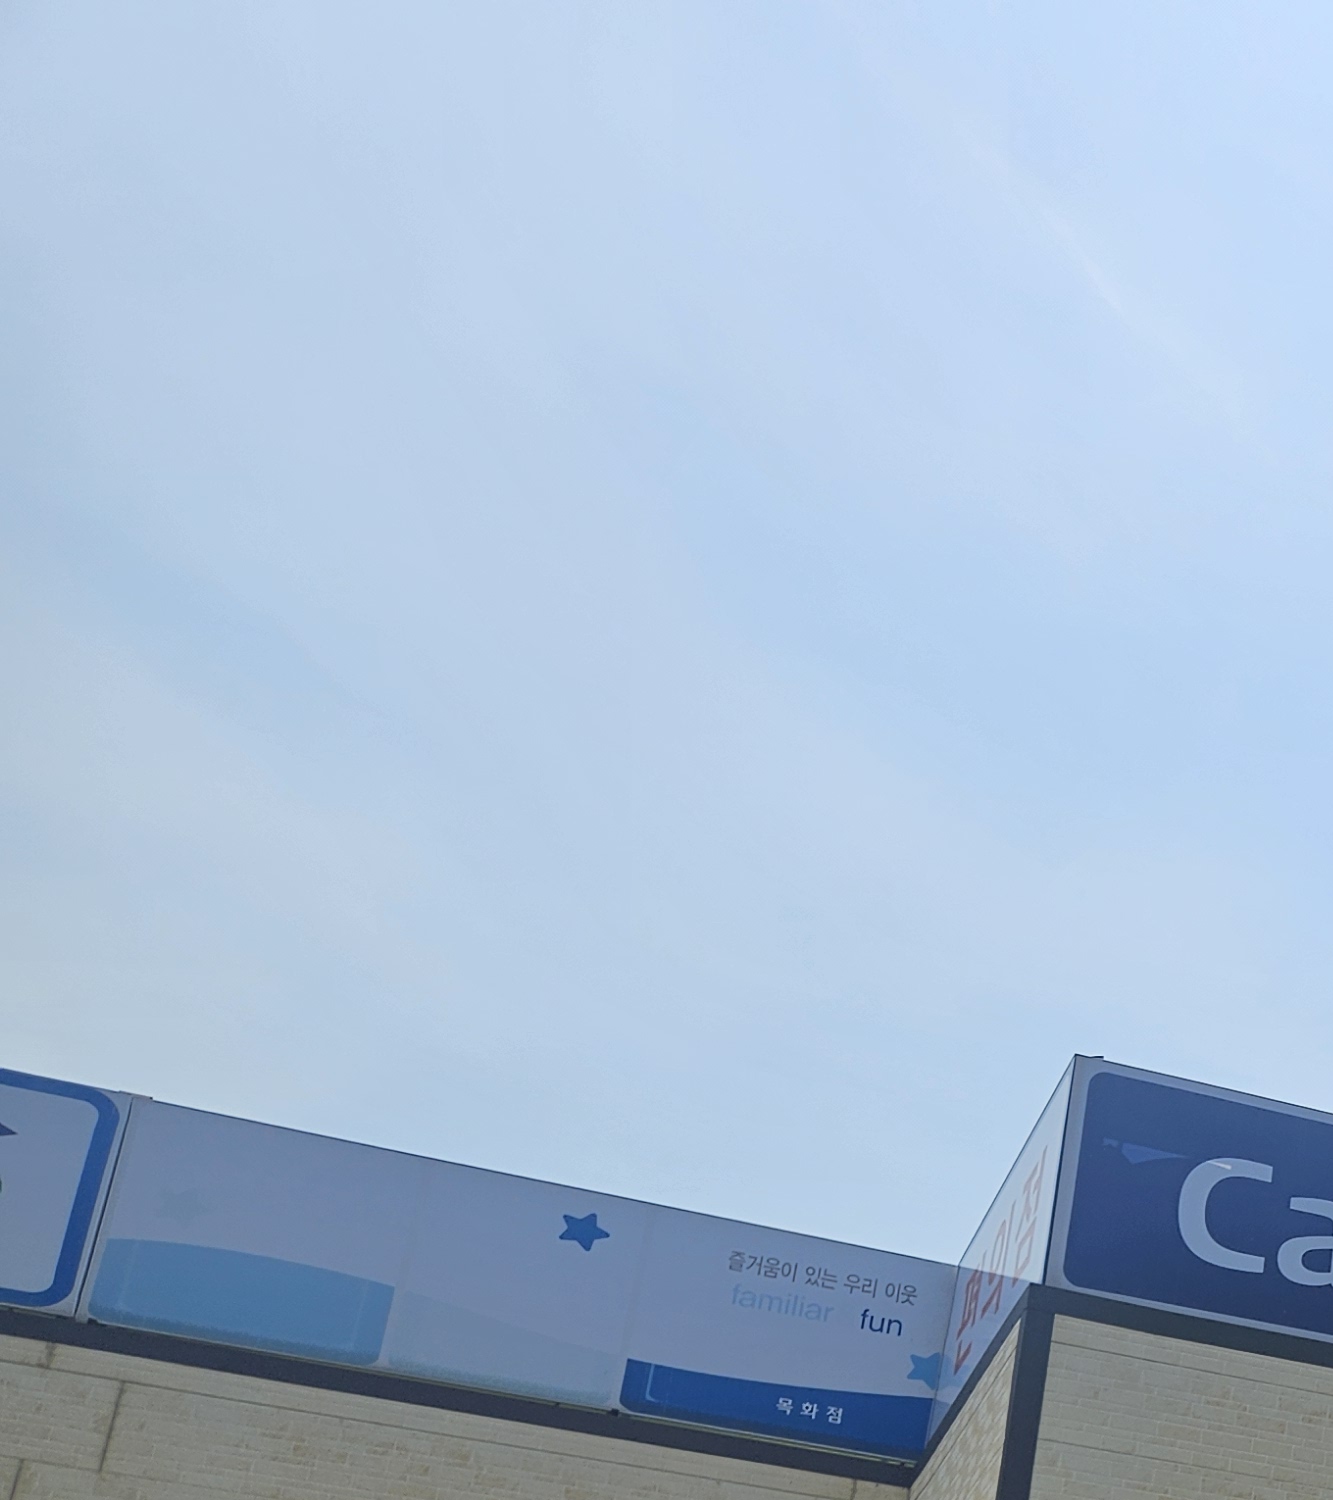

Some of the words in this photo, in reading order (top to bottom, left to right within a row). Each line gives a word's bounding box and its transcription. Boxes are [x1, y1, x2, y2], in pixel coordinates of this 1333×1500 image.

[728, 1250, 799, 1283] 즐거움이
[805, 1265, 838, 1290] 있는
[843, 1274, 878, 1299] 우리
[885, 1283, 918, 1306] 이웃
[953, 1145, 1048, 1376] 편의점
[731, 1283, 835, 1322] familiar
[860, 1309, 903, 1336] fun
